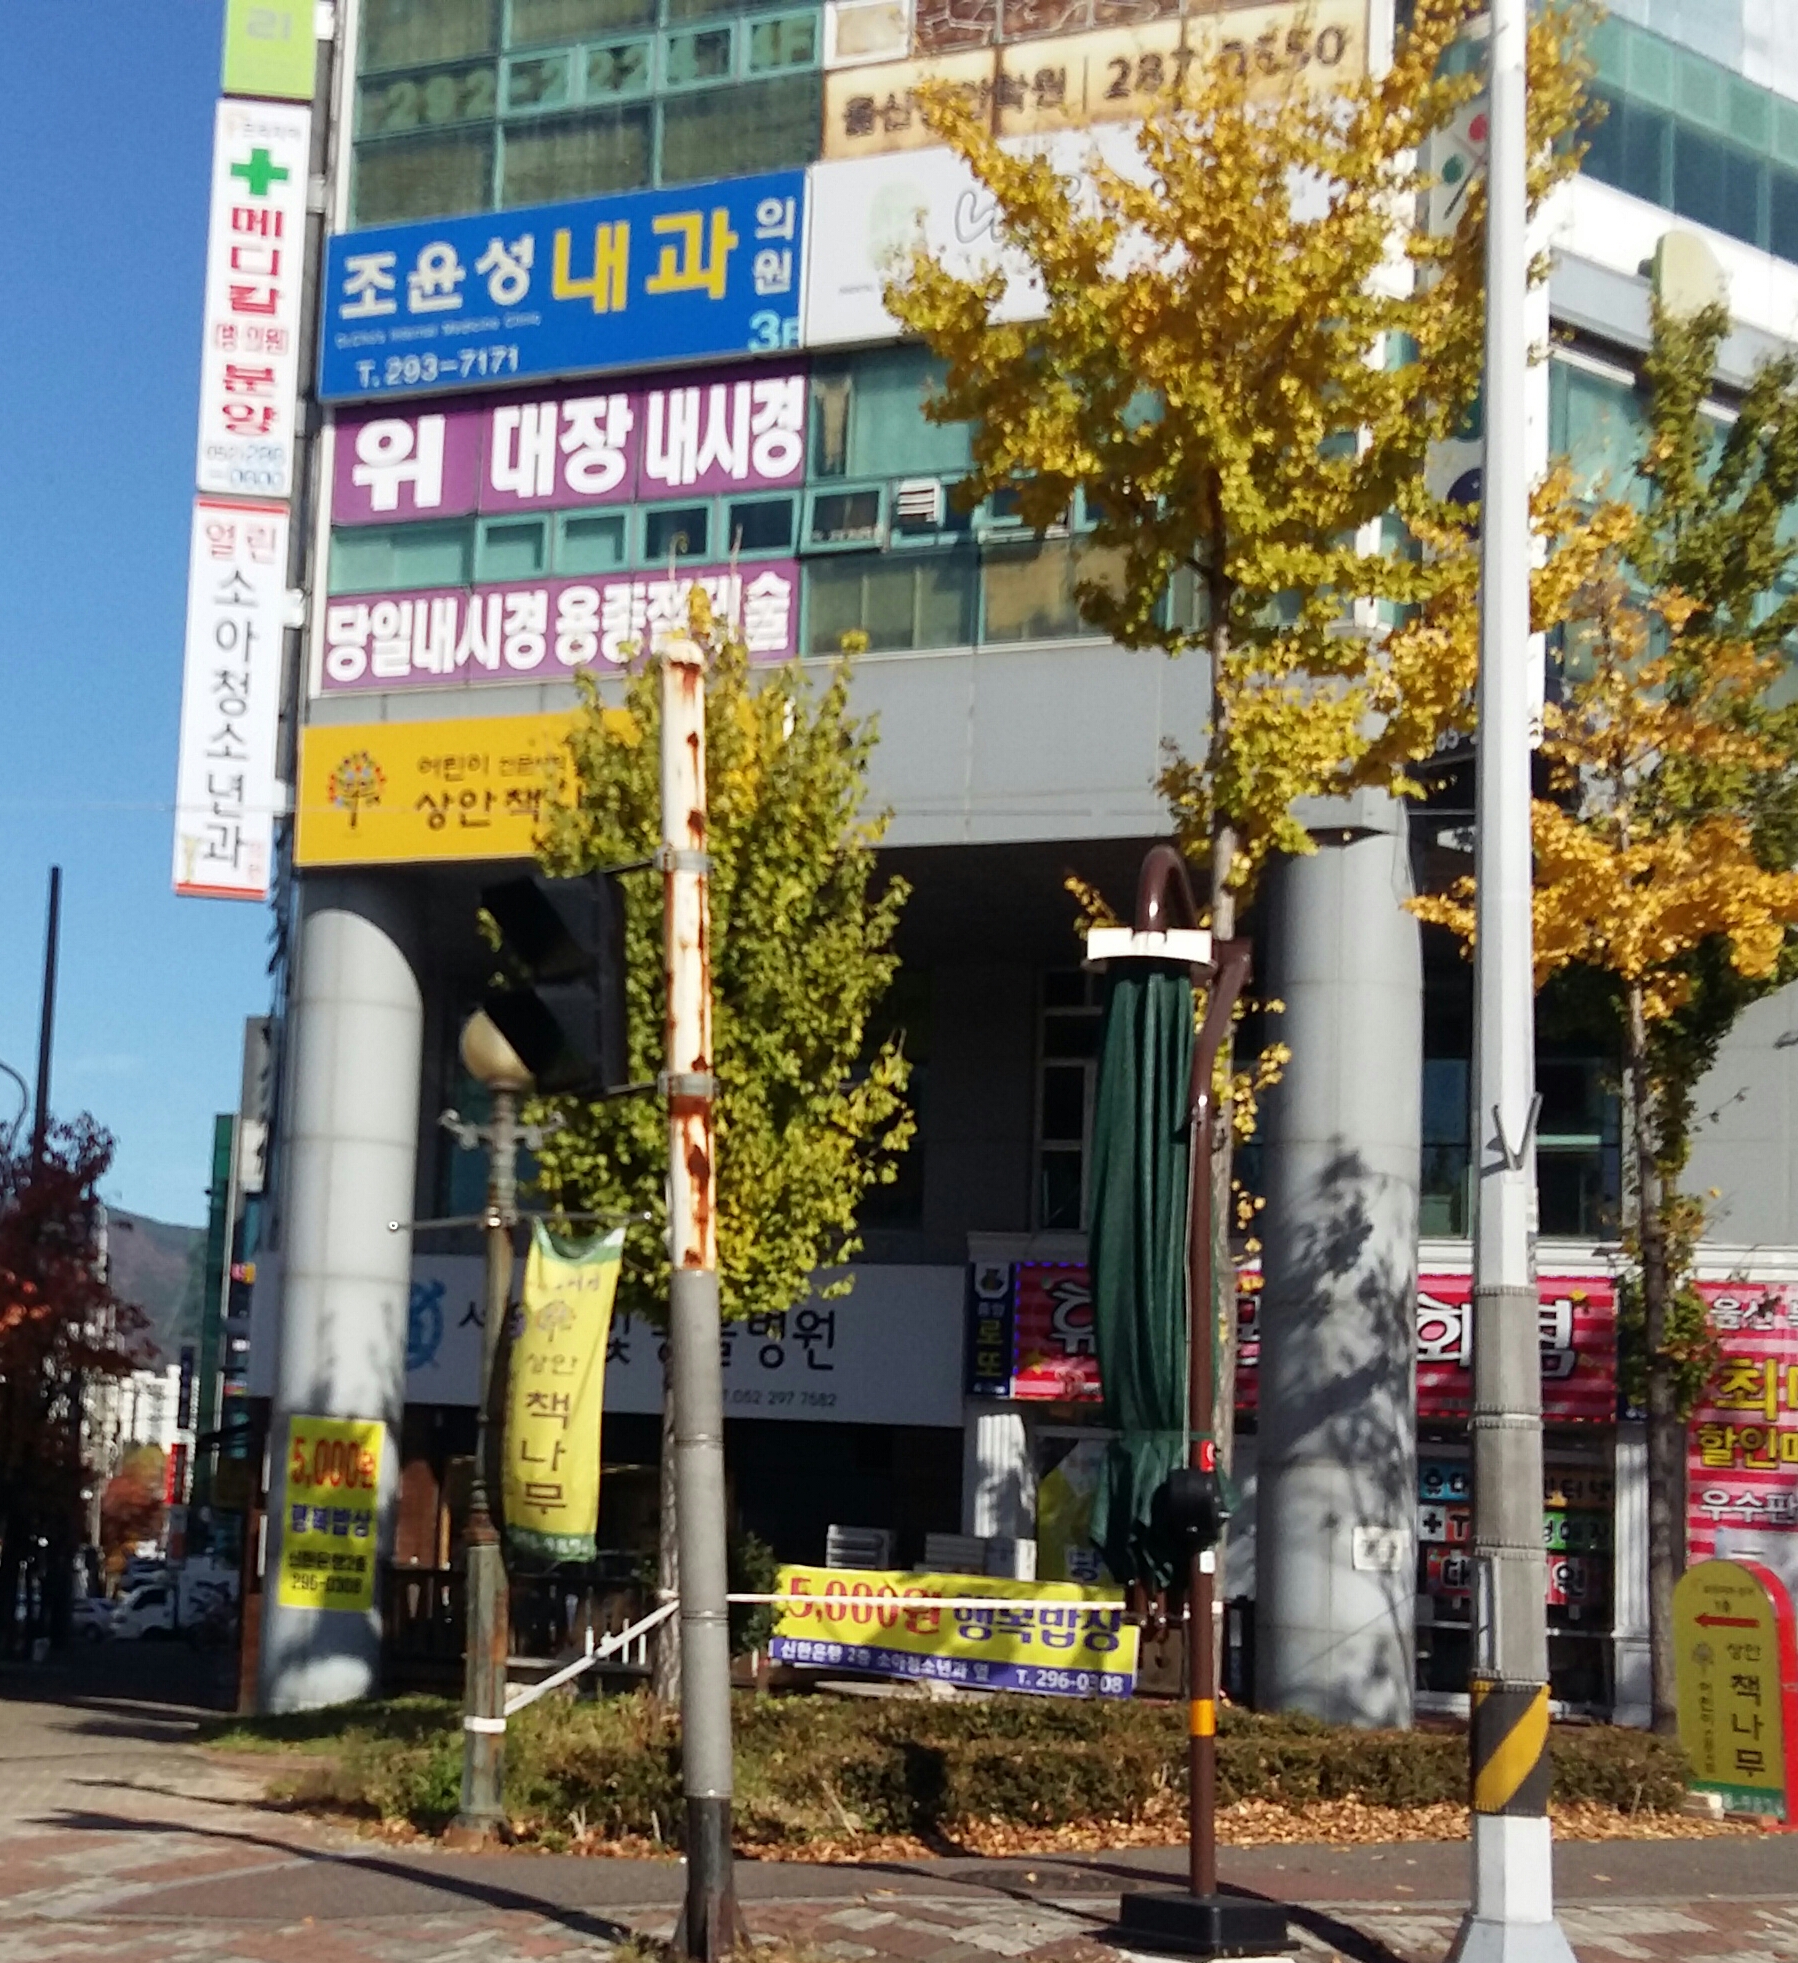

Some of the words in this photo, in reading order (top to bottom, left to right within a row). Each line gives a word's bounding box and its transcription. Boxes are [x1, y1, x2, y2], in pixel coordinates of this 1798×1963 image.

[748, 310, 799, 352] 3F
[352, 413, 446, 511] 위
[490, 393, 634, 498] 대장
[645, 374, 806, 486] 내시경
[203, 569, 258, 869] 소아청소년과
[787, 1576, 942, 1635] 5,000원
